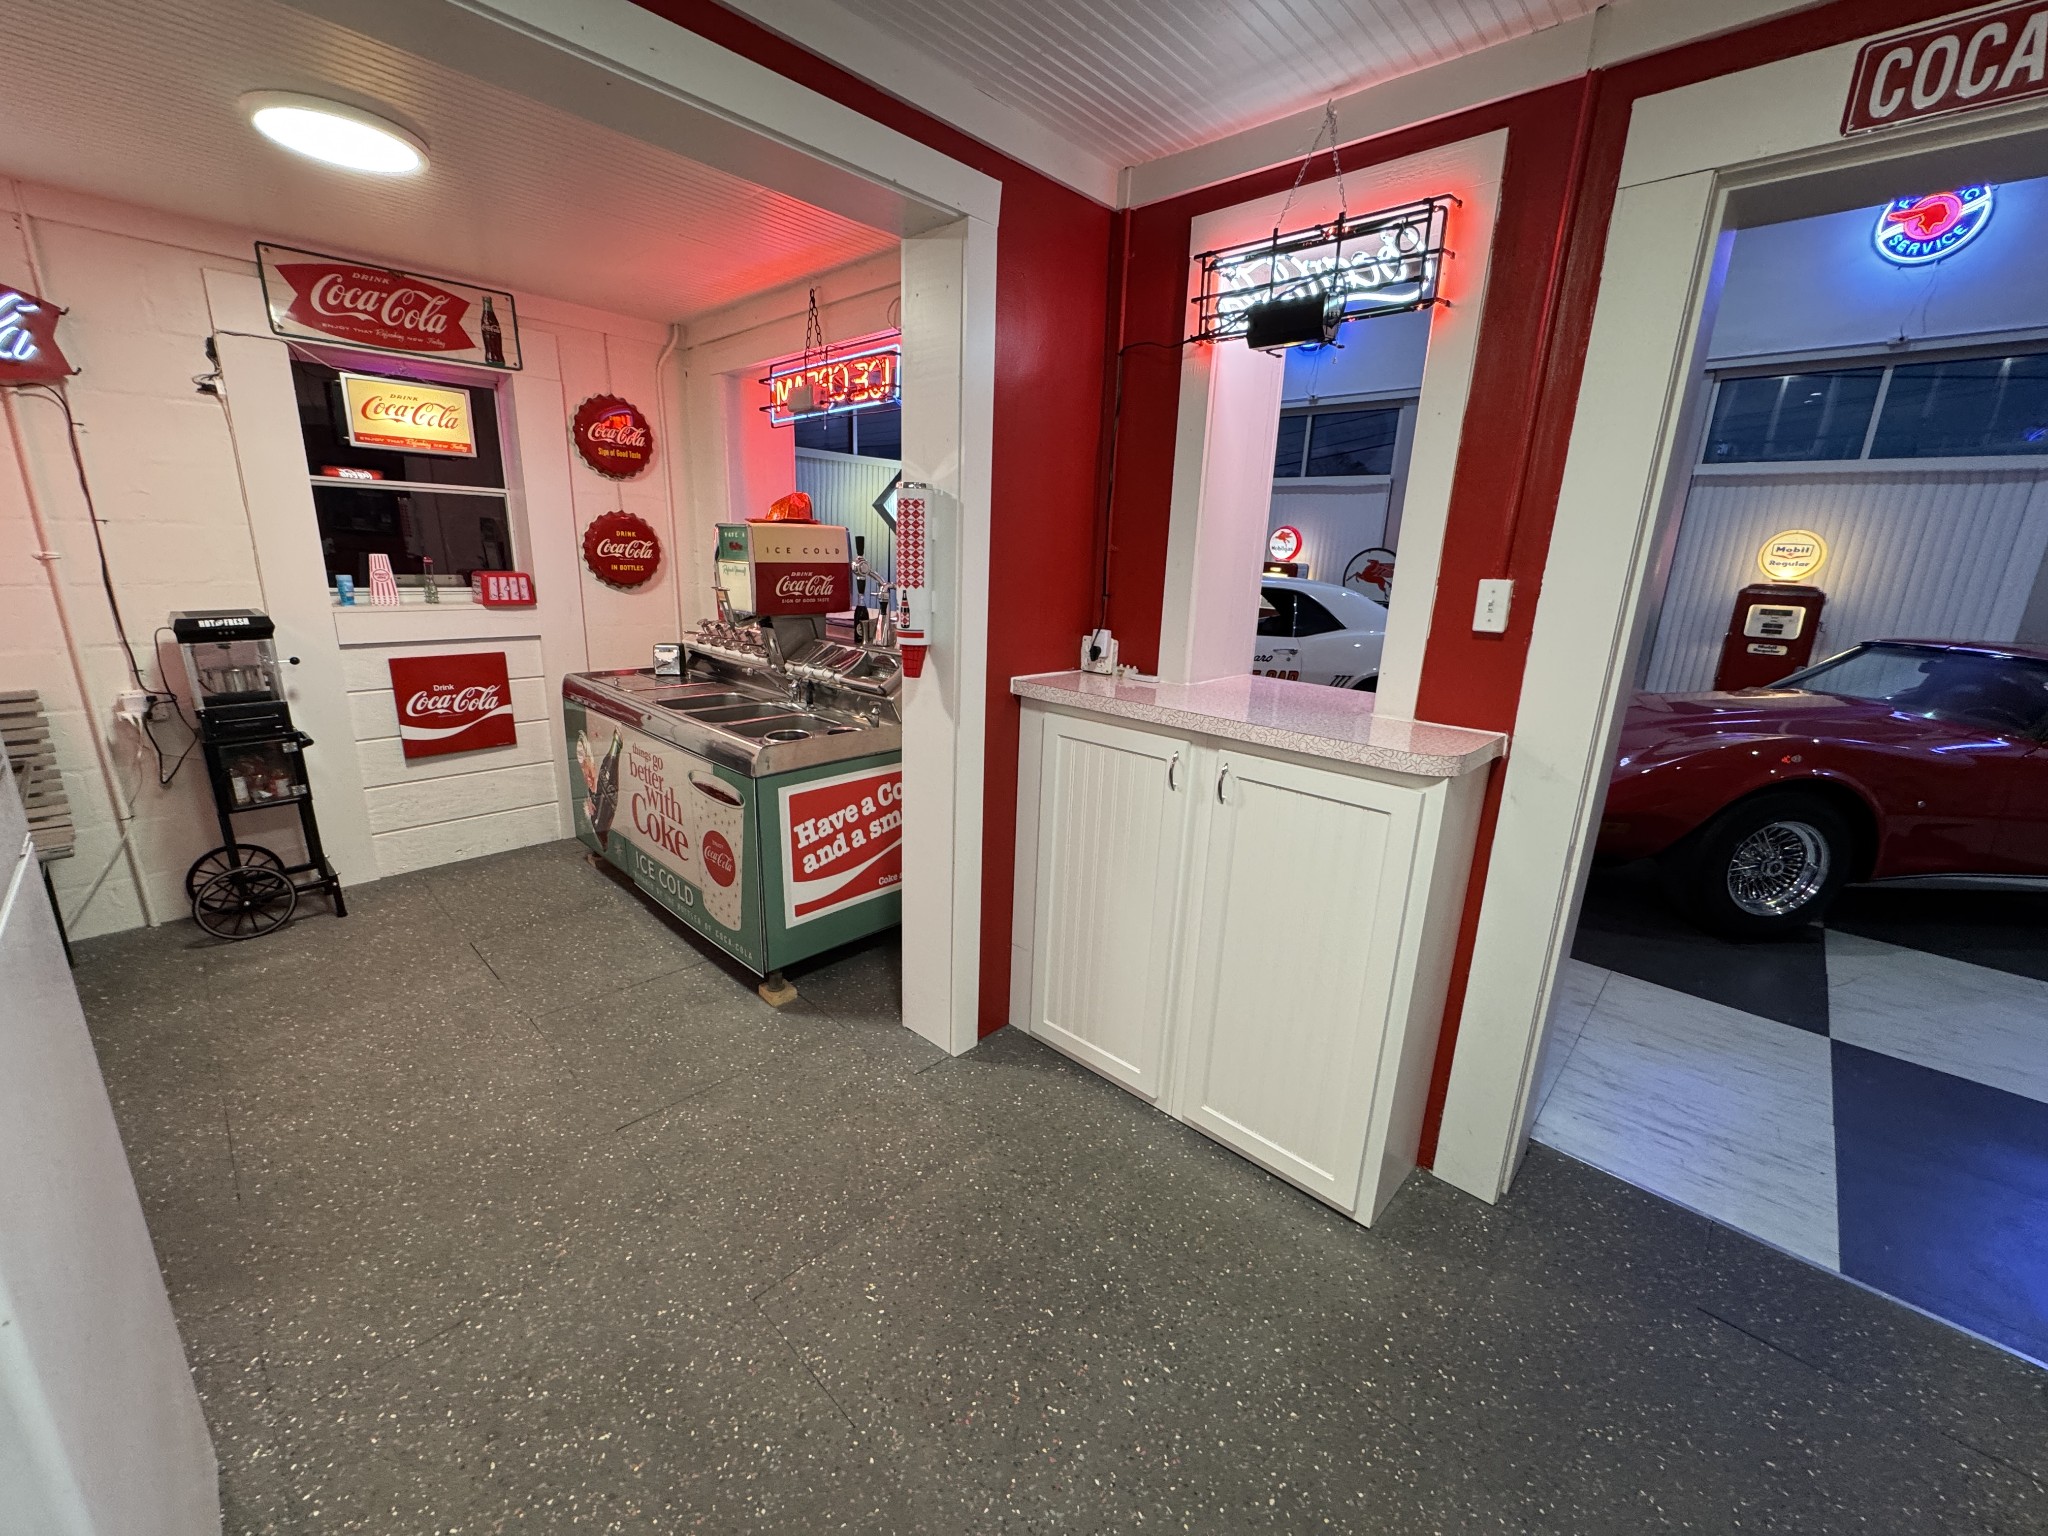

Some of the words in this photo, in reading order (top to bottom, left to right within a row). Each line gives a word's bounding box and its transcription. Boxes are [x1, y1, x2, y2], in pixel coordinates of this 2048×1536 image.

[1869, 9, 2048, 119] COCA
[1889, 225, 1968, 256] SERVICE
[352, 272, 391, 285] DRINK
[310, 273, 450, 334] Coca-Cola
[361, 395, 462, 430] Coca-Cola
[587, 421, 646, 447] Coca-Cola
[598, 447, 610, 457] Sign
[616, 449, 628, 458] Good
[597, 538, 654, 559] Coca-Cola
[616, 530, 636, 538] DRINK
[775, 575, 835, 597] Coca-Cola
[198, 620, 215, 628] HOT
[223, 617, 250, 627] FRESH
[406, 684, 501, 717] Coca-Cola
[433, 684, 454, 692] Drink
[632, 742, 651, 762] things
[653, 754, 664, 771] go
[628, 752, 664, 792] better
[644, 785, 683, 826] with
[632, 792, 689, 861] Coke
[793, 803, 859, 849] Have
[861, 796, 876, 816] a
[802, 832, 850, 874] and
[851, 828, 867, 848] a
[869, 809, 902, 840] sm
[704, 845, 732, 872] Coca-Cola
[635, 851, 655, 880] ICE
[659, 868, 694, 907] COLD
[878, 874, 898, 886] Coke
